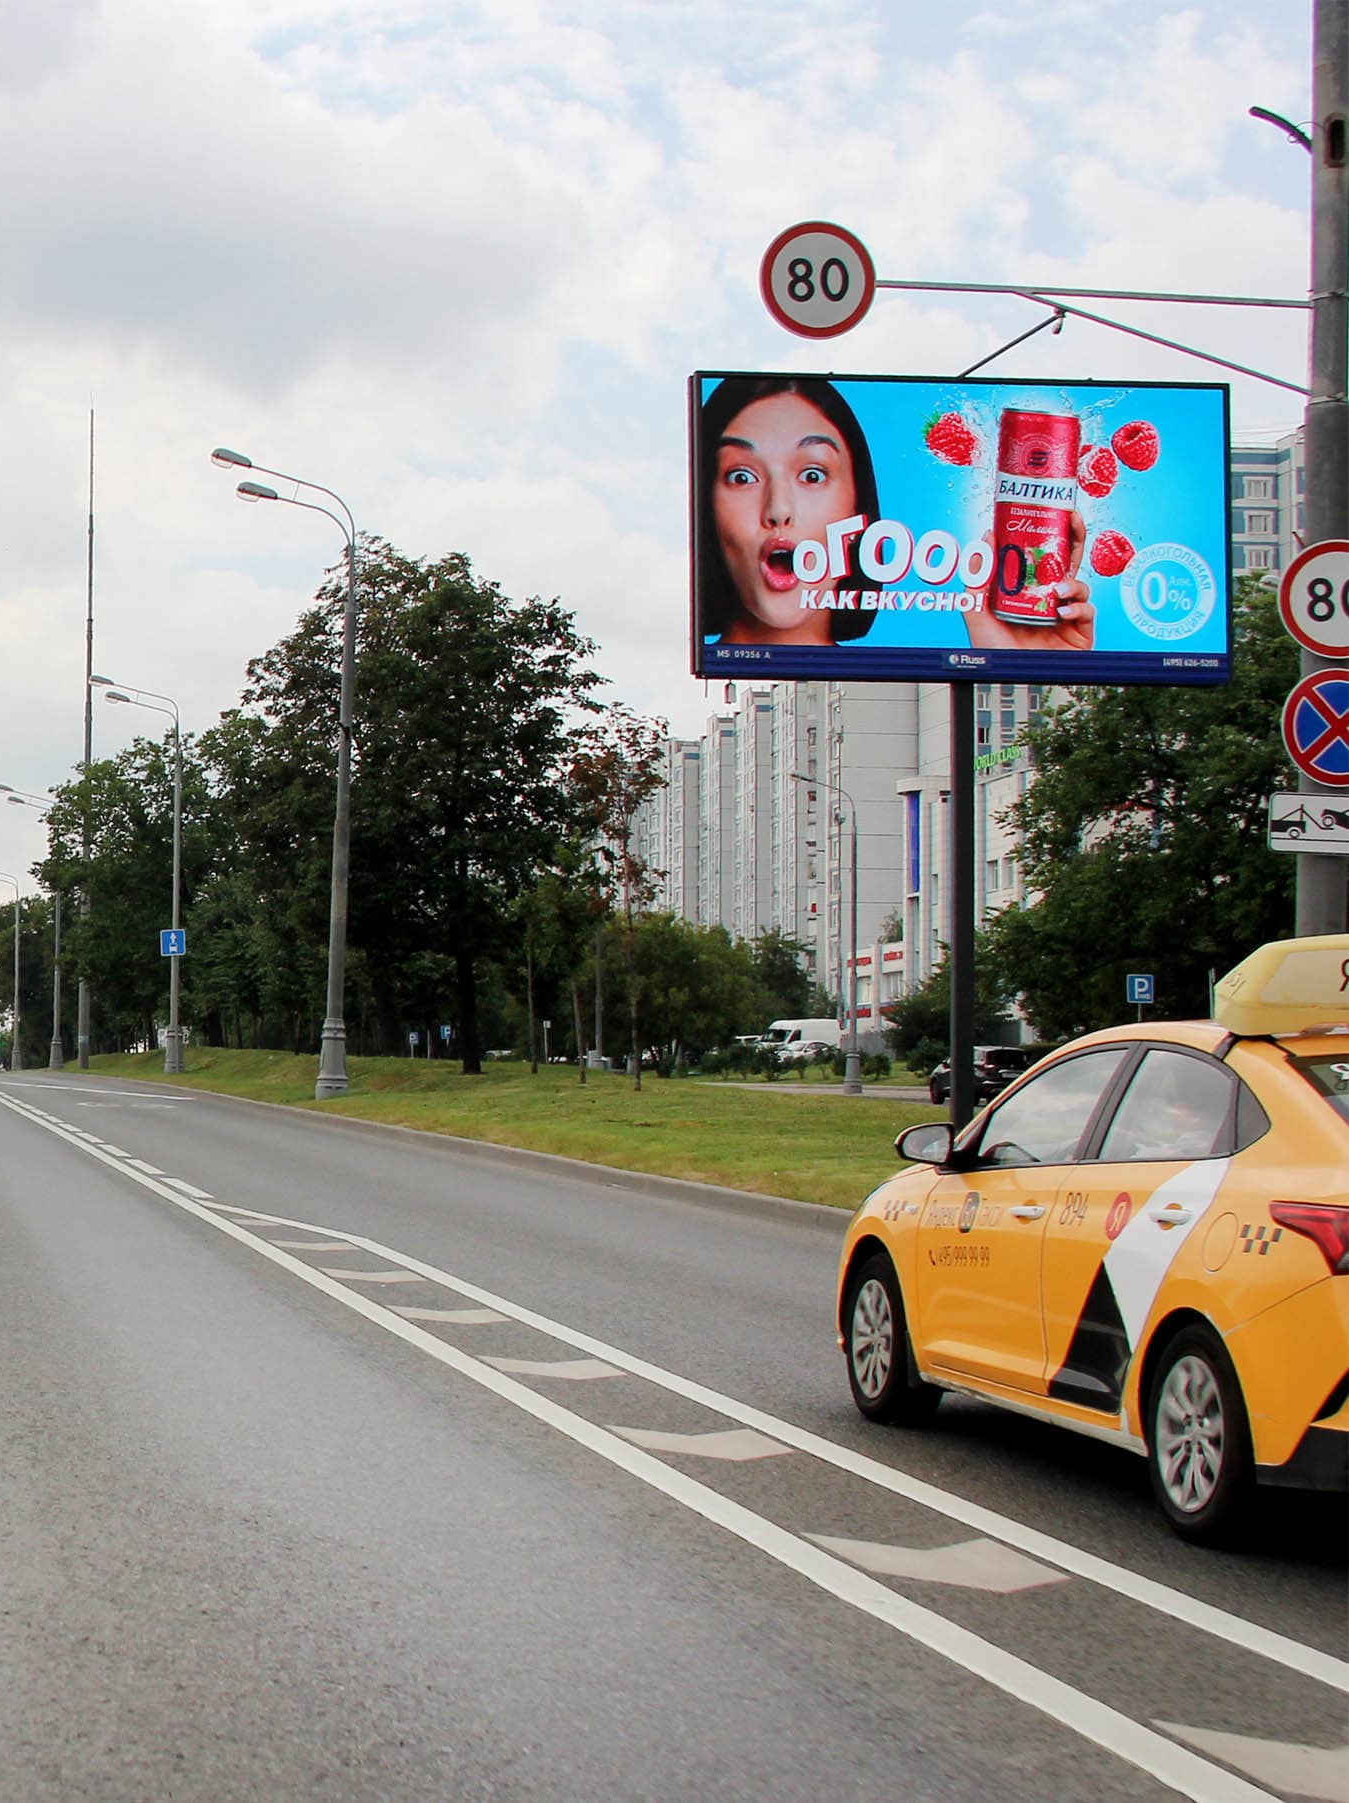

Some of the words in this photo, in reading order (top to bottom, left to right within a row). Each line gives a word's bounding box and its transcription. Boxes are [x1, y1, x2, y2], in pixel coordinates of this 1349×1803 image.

[788, 257, 849, 302] 80
[999, 480, 1074, 501] БАЛТИКА
[800, 589, 859, 610] КАК
[860, 590, 987, 613] ВКУСНО!
[716, 650, 730, 659] MS
[960, 654, 986, 664] Russ
[1134, 977, 1148, 999] P
[1058, 1191, 1090, 1227] 894
[1109, 1200, 1127, 1232] Я
